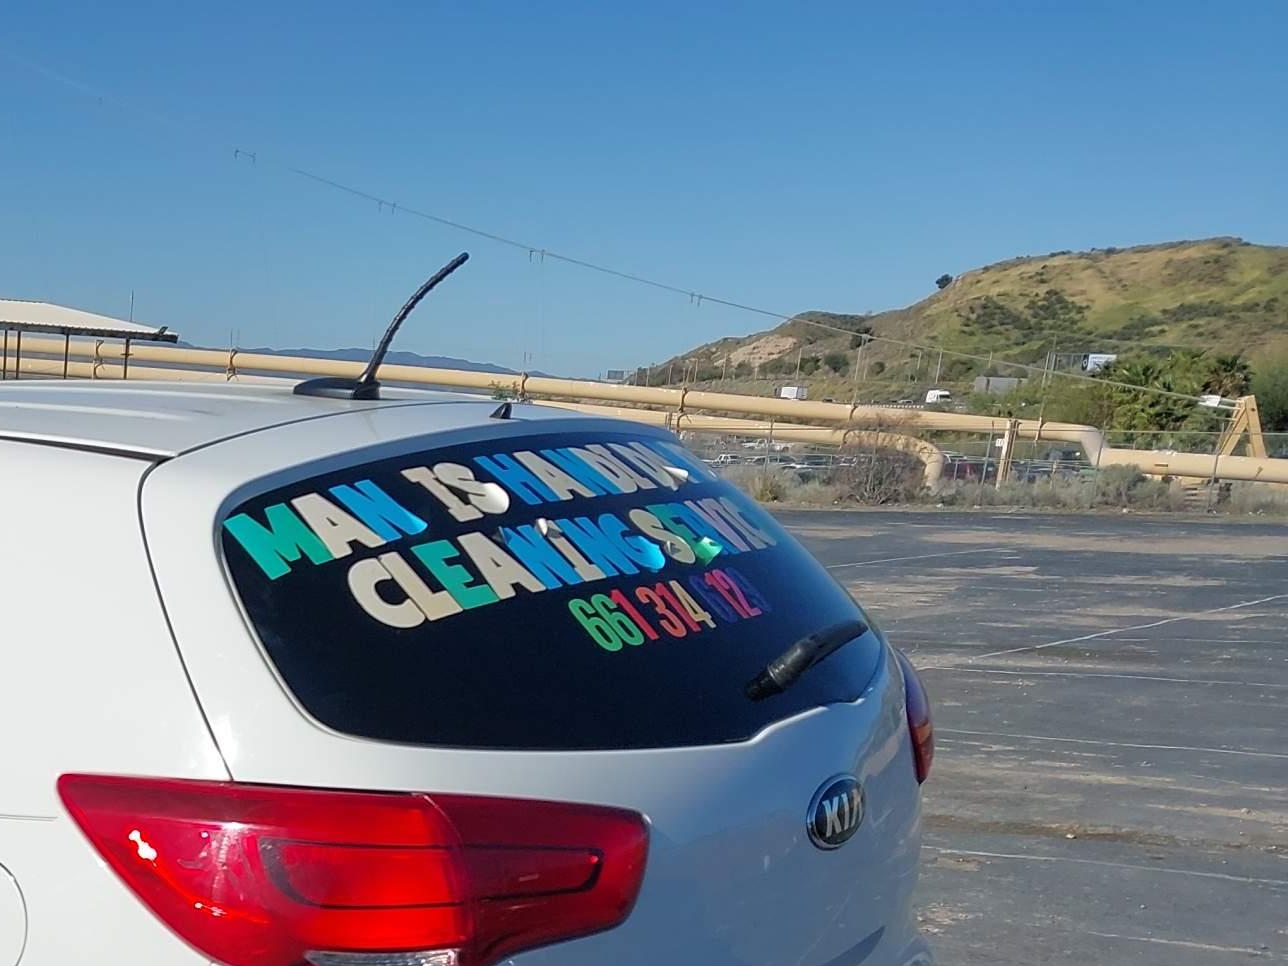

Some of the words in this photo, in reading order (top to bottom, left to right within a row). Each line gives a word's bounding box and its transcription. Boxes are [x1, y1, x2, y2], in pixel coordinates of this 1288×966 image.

[223, 479, 428, 580] MAN
[400, 462, 510, 522] IS
[347, 511, 666, 629] CLEANING
[567, 588, 661, 652] 661
[635, 579, 717, 638] 314
[821, 788, 863, 838] KIA
